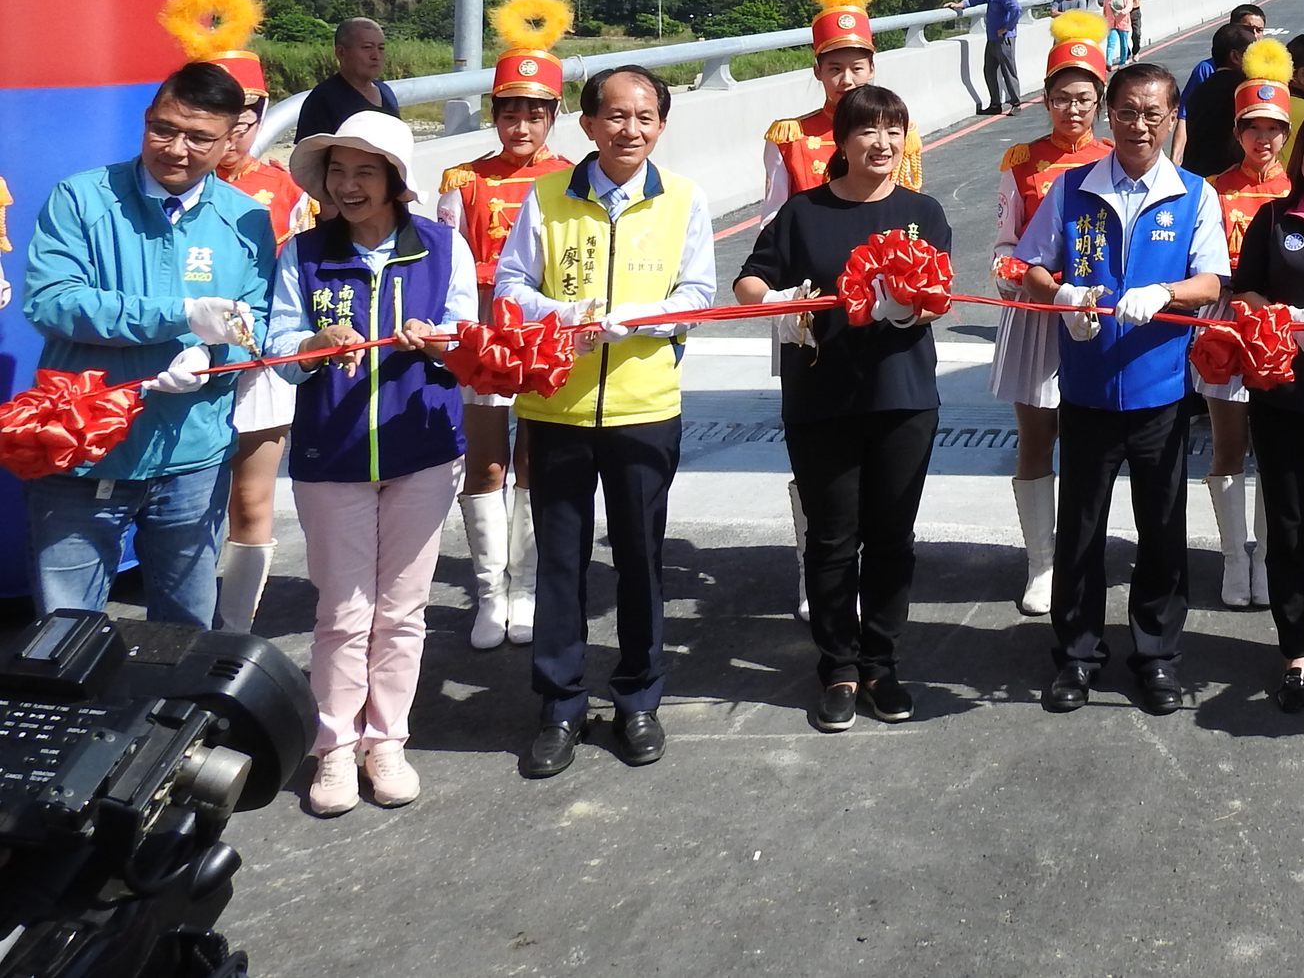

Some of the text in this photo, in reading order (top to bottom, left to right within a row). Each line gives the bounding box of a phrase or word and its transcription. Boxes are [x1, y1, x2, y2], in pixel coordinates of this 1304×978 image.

[1151, 229, 1176, 242] KMT
[186, 246, 213, 272] 英
[583, 235, 597, 285] 埔里鎮長
[183, 271, 213, 282] 2020
[559, 246, 581, 303] 廖志
